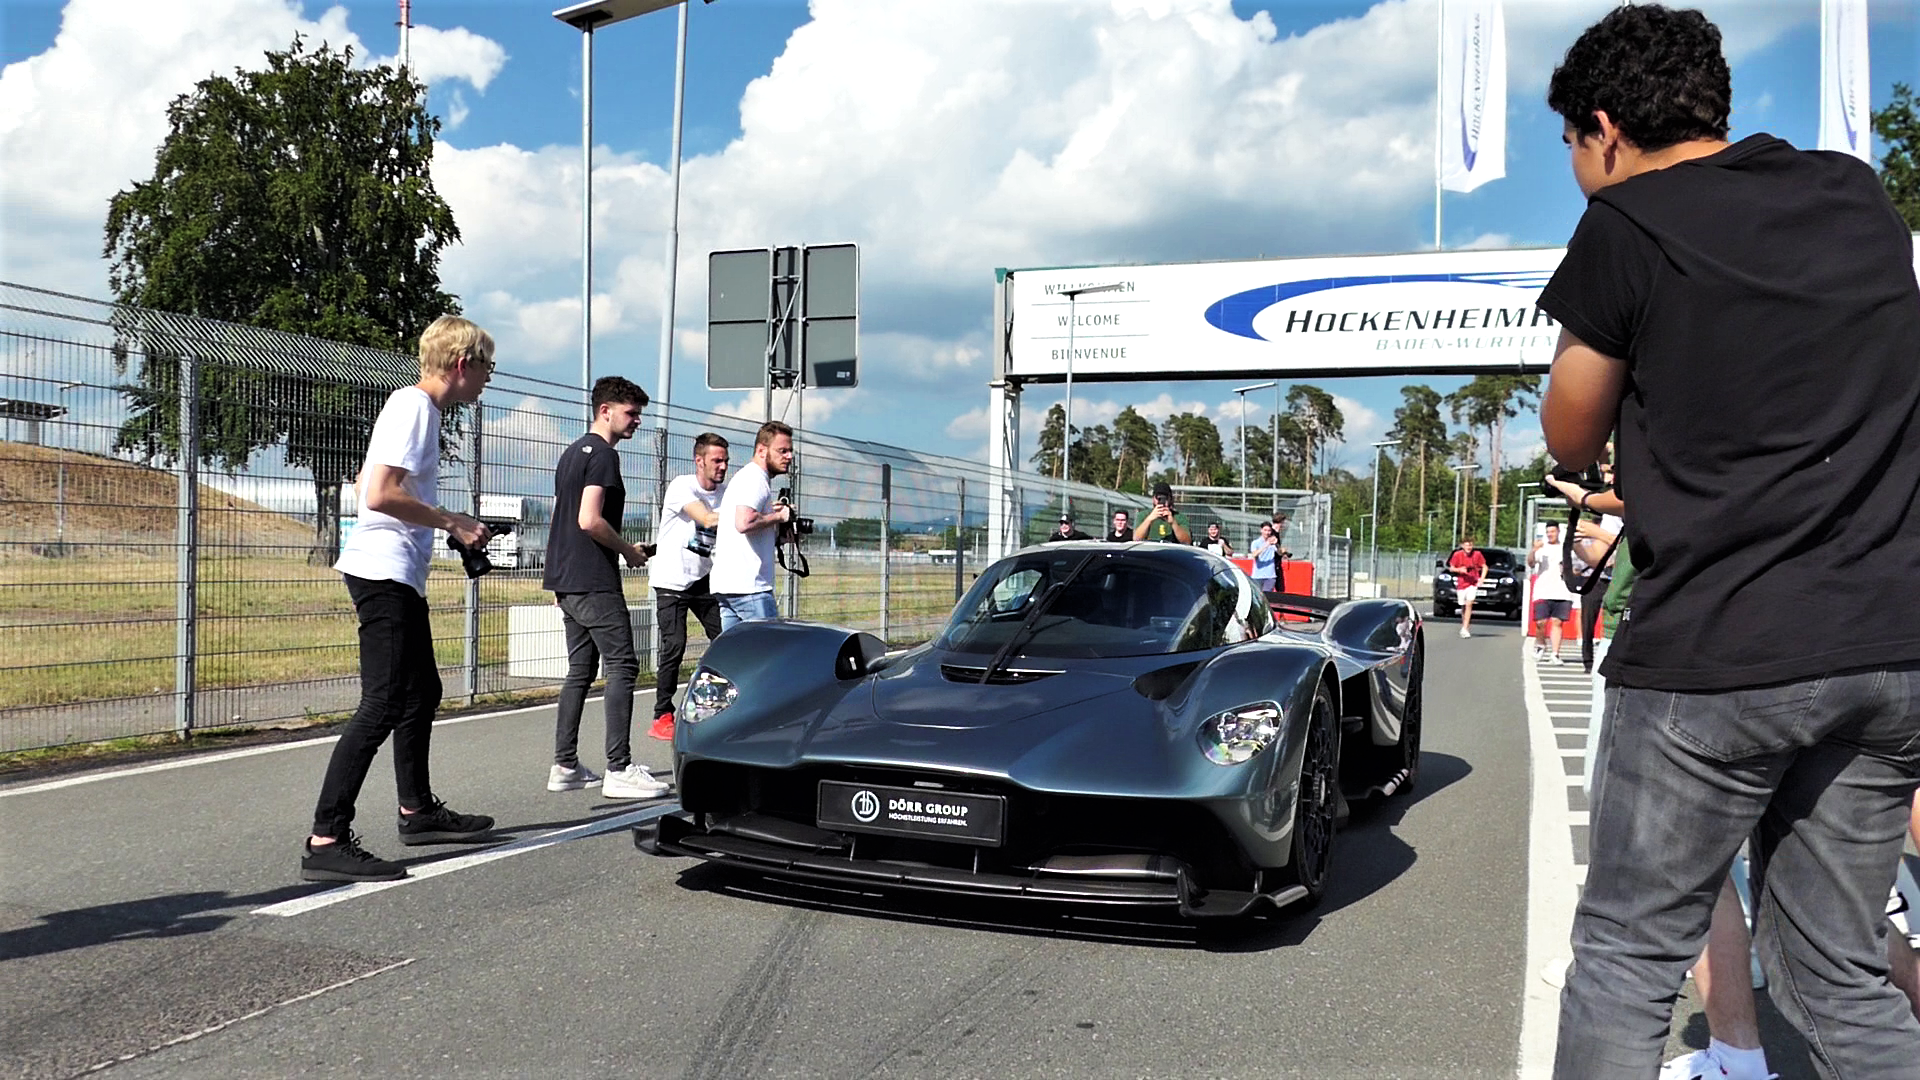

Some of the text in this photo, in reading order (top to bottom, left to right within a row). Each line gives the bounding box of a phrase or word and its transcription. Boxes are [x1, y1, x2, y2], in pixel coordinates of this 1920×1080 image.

[1045, 281, 1135, 295] WILEN
[1058, 314, 1120, 326] WELCOME
[889, 798, 968, 817] DÖRR GROUP
